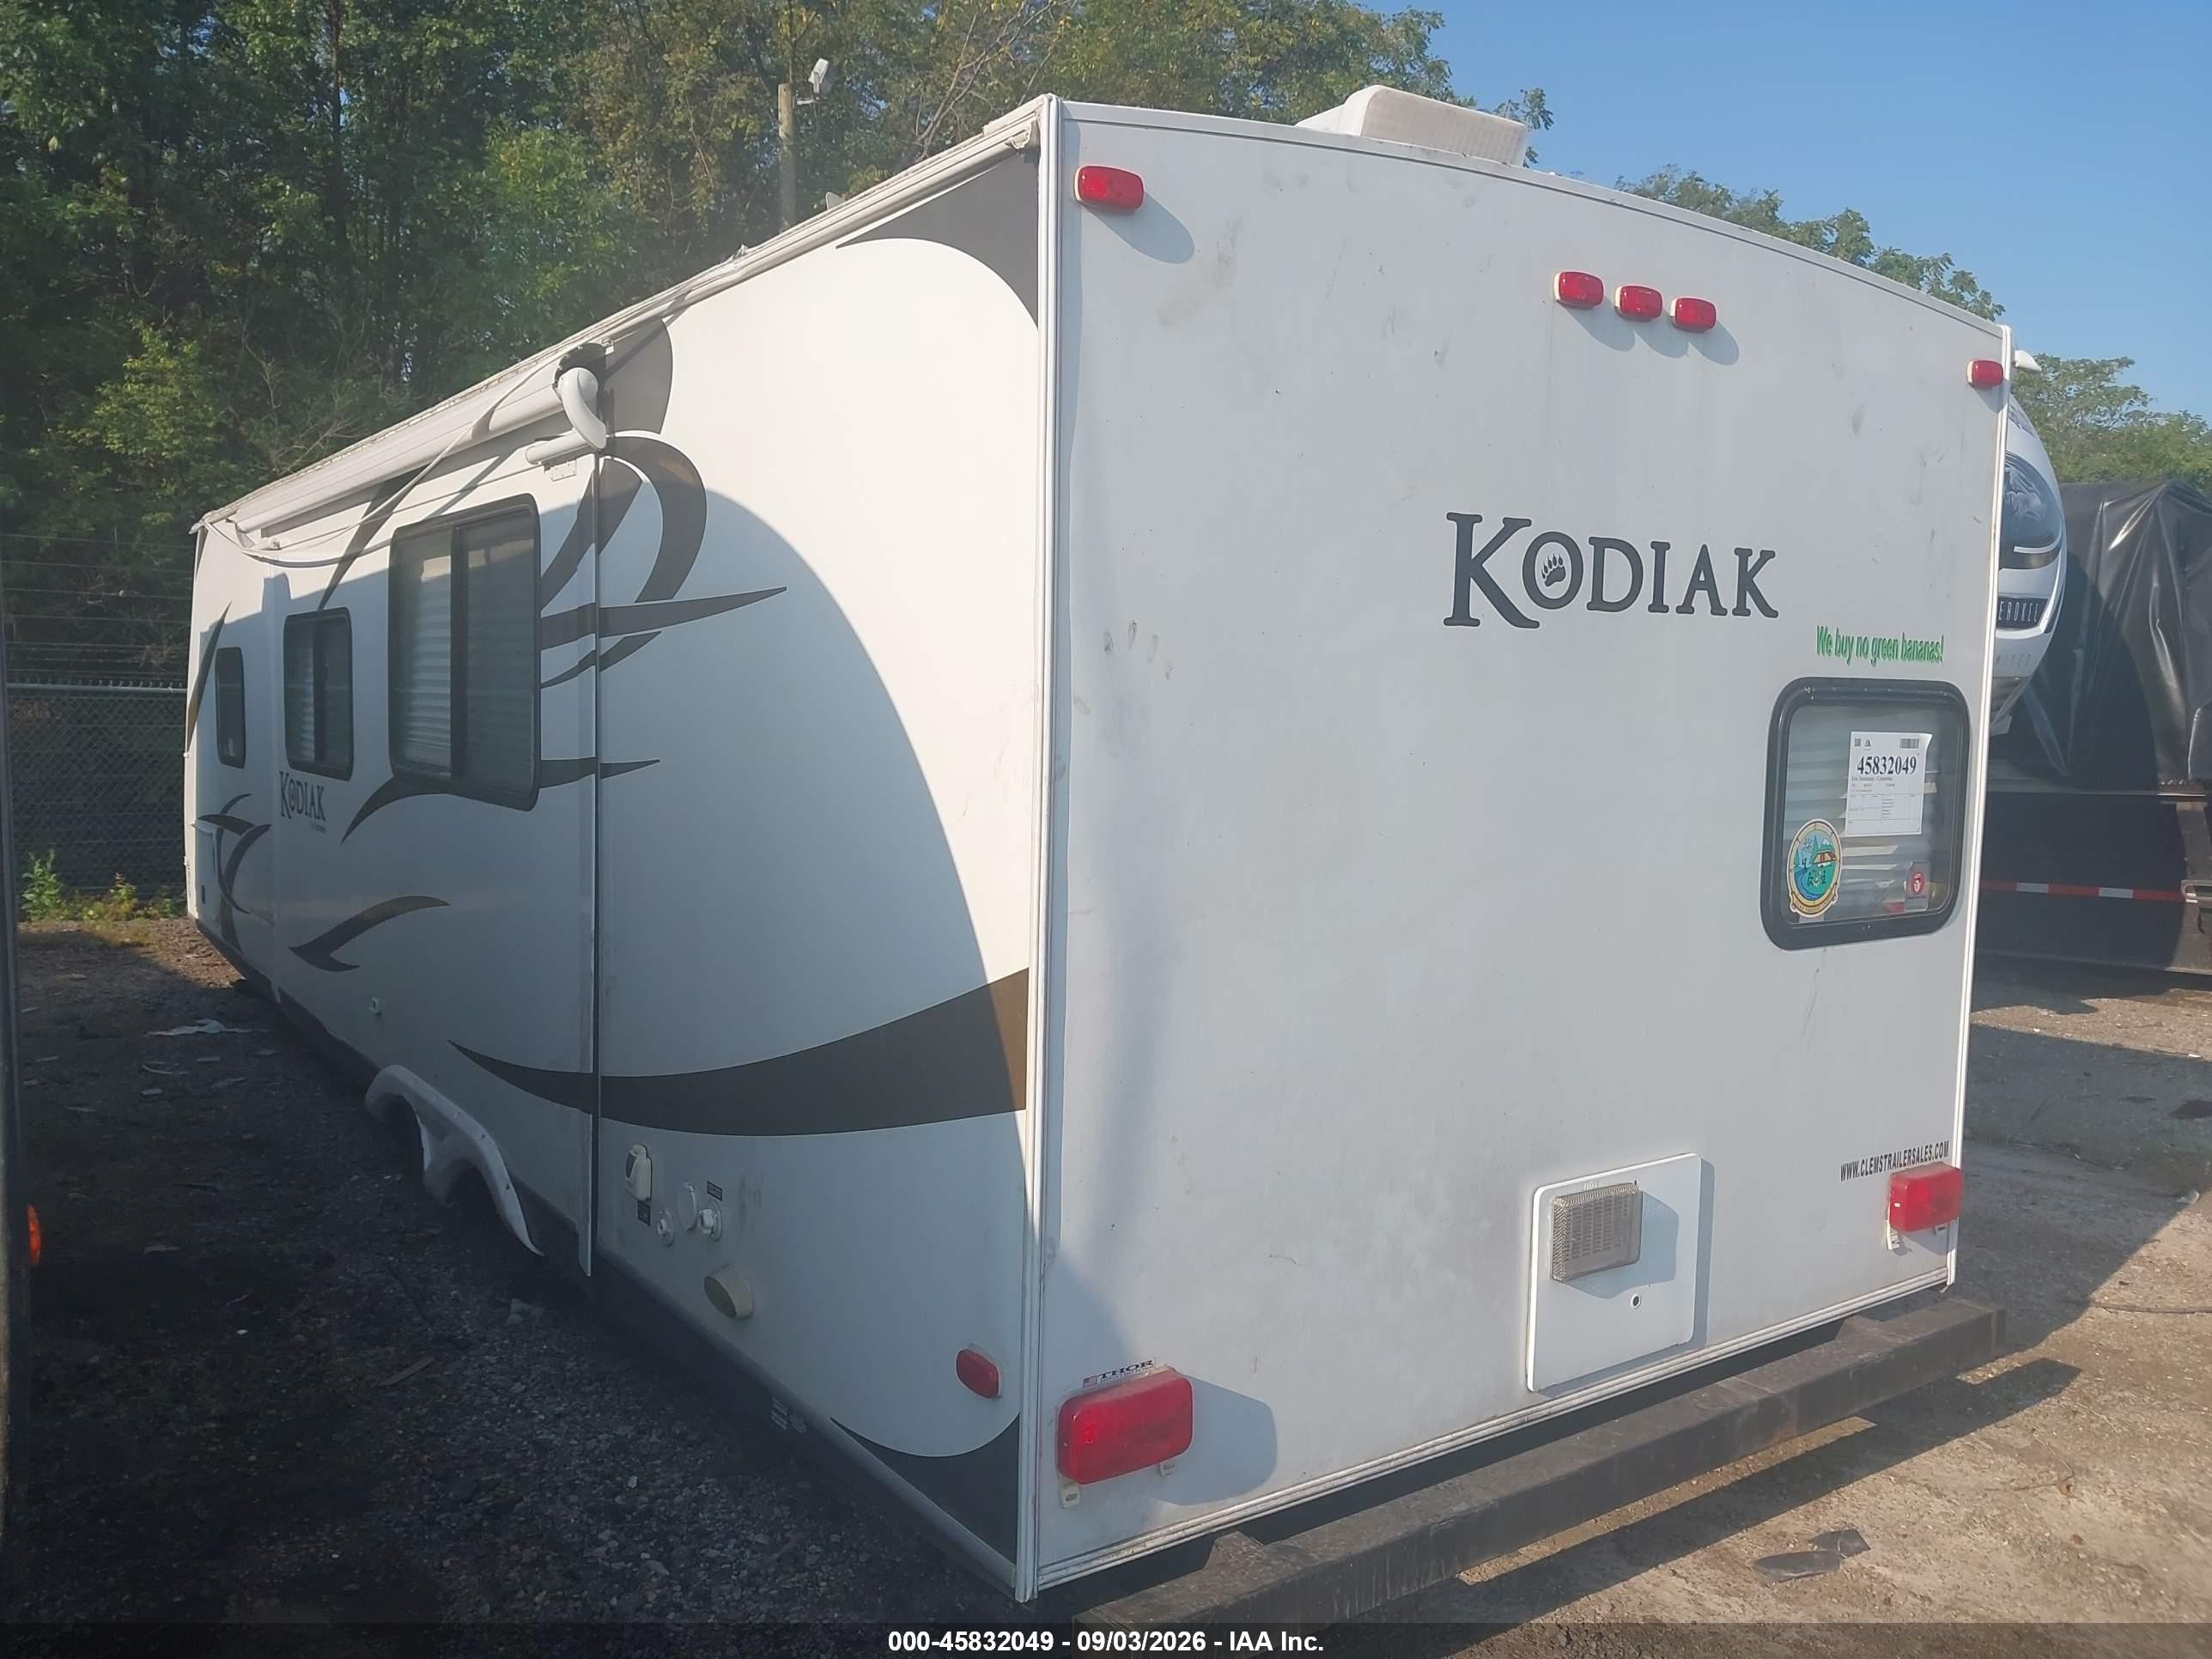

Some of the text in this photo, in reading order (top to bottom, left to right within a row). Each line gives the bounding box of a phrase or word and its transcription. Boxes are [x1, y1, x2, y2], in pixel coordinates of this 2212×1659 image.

[1443, 512, 1778, 629] KODIAK
[1999, 600, 2039, 622] EROKEE
[1817, 625, 1944, 666] We buy no green bananas!
[1857, 756, 1917, 775] 45832049
[279, 771, 326, 821] KODIAK
[1840, 1140, 1949, 1182] WWW.CLEMSTRAILERSALES.COM
[1097, 1359, 1154, 1379] THOR
